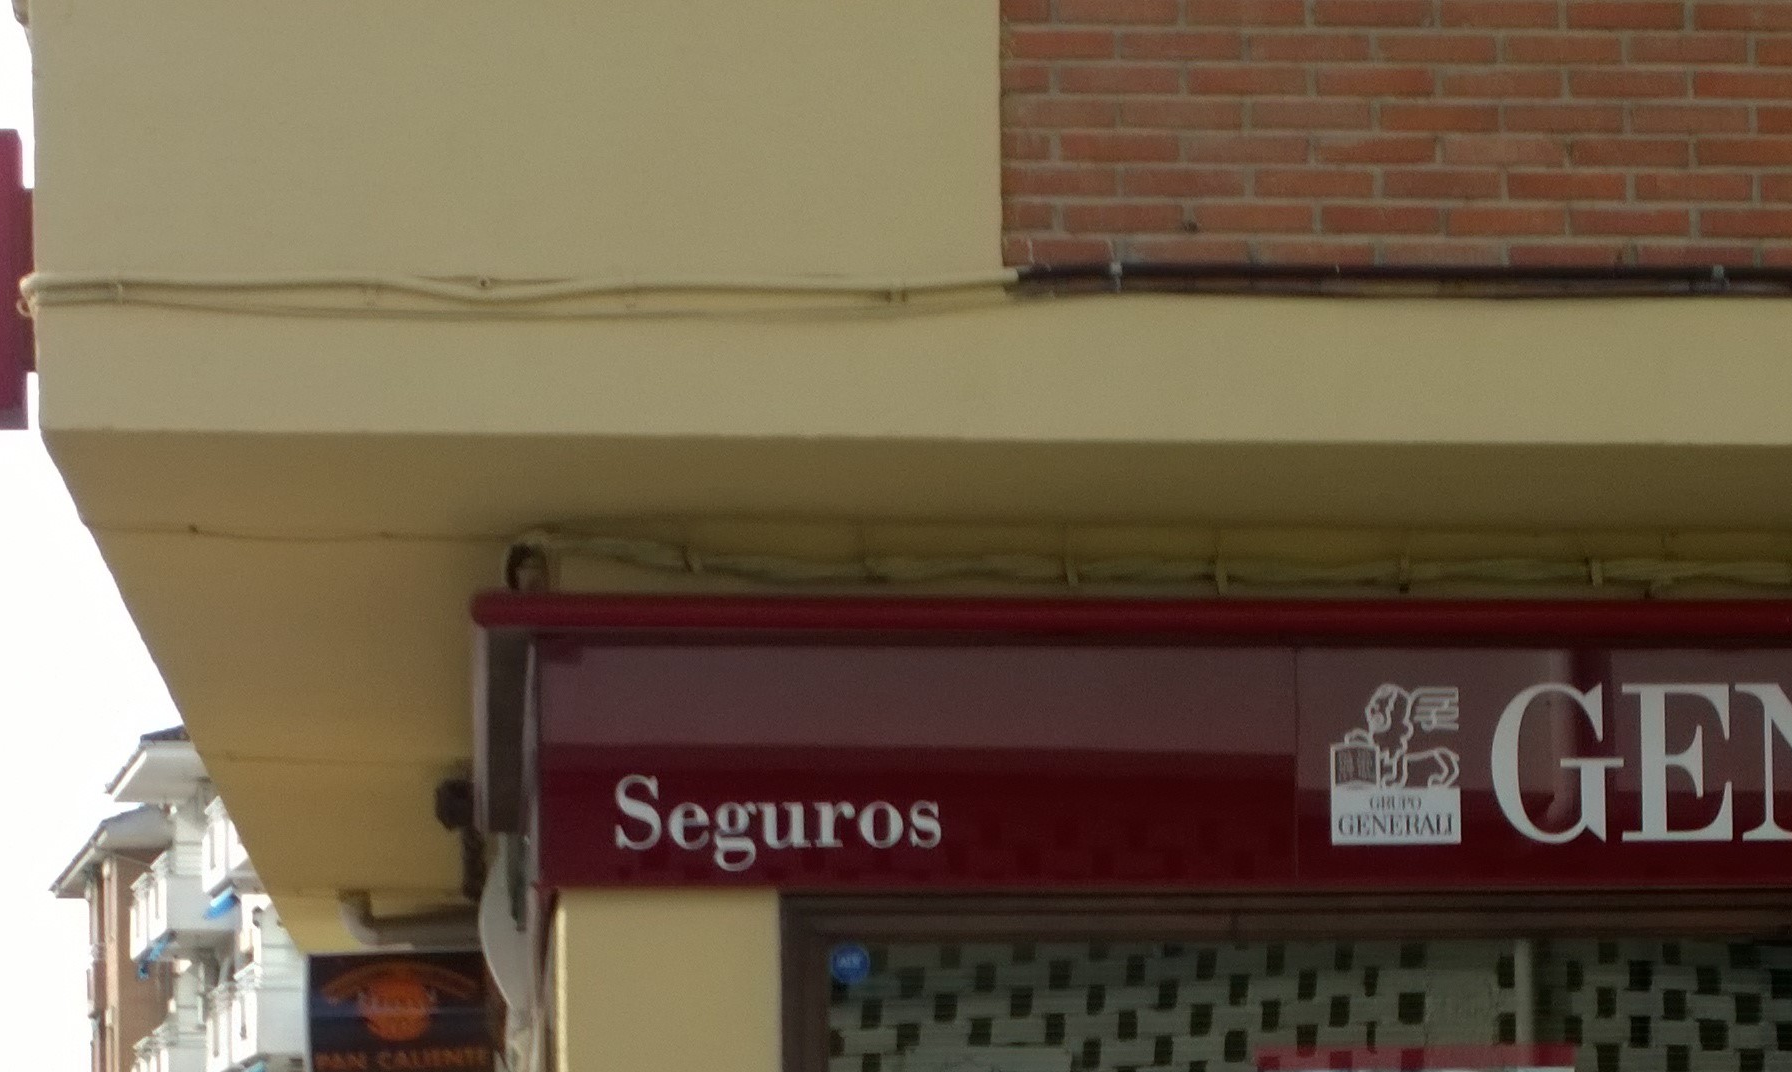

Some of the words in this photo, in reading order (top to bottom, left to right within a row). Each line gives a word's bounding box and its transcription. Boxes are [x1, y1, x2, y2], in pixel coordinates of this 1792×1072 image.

[1369, 795, 1422, 810] GRUPO
[613, 774, 943, 872] Seguros
[1338, 813, 1453, 836] GENERALI
[315, 1051, 368, 1071] PAN
[375, 1046, 491, 1070] CALIENTE
